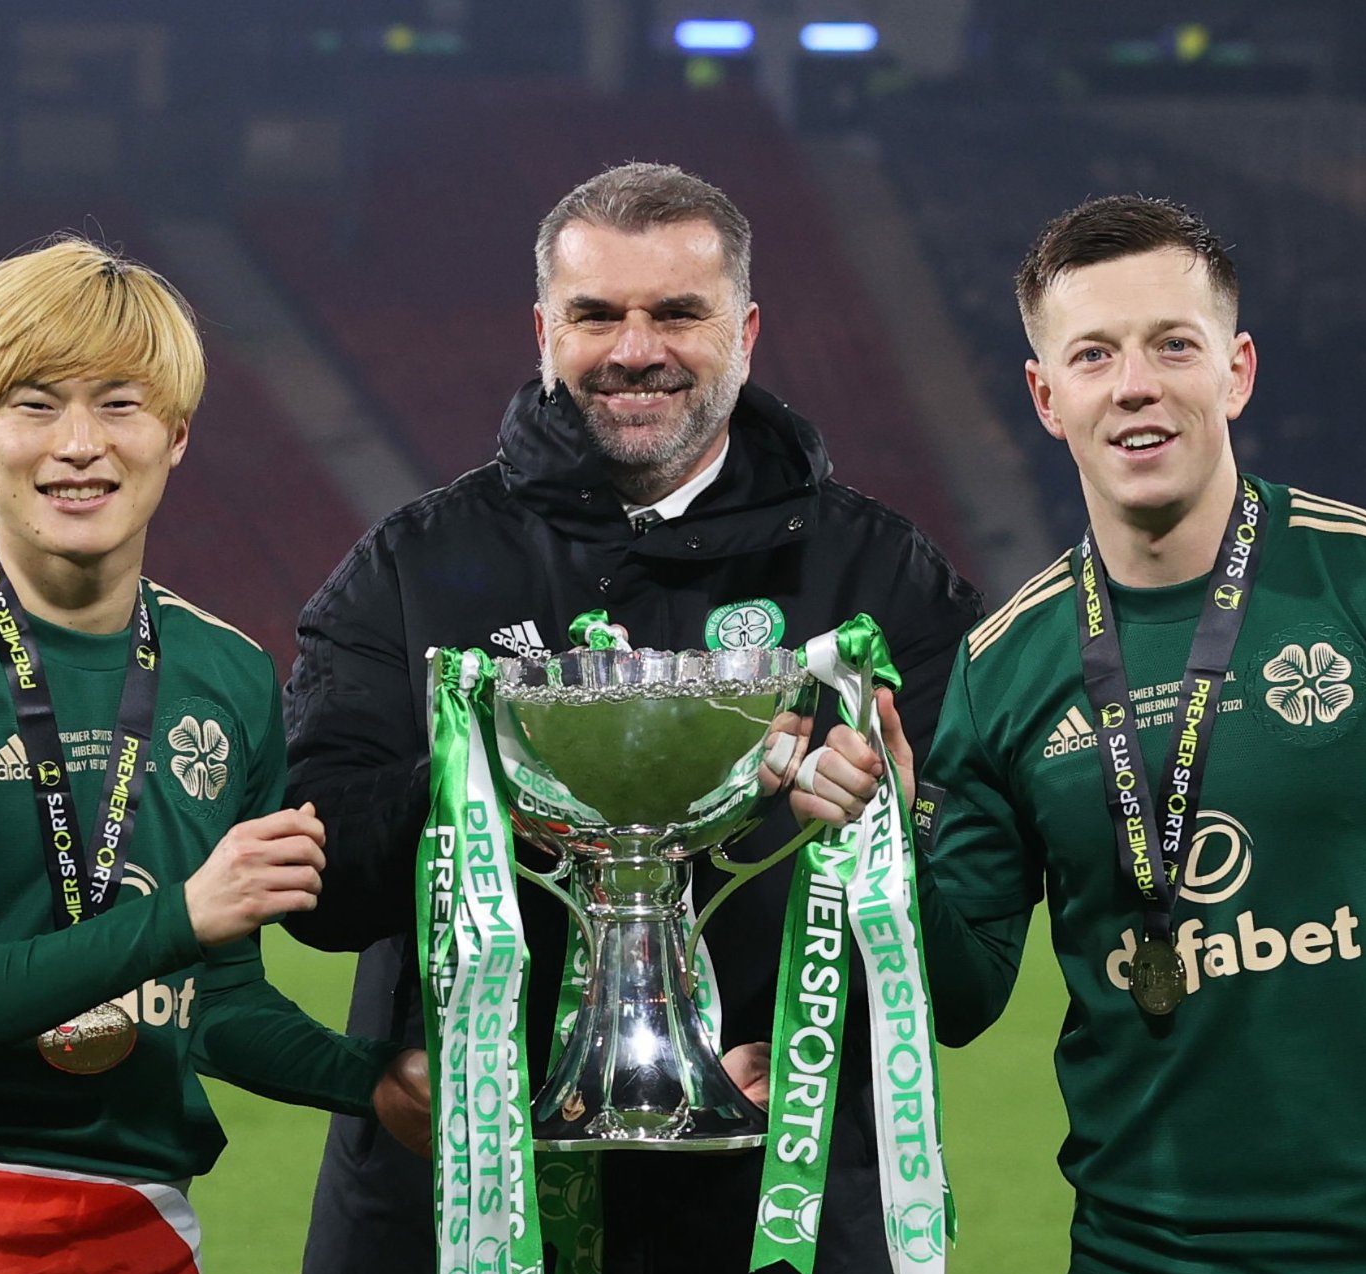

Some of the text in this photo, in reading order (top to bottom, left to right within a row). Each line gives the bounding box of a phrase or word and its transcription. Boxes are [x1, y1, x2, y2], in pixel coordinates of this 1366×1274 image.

[707, 621, 717, 637] THE
[768, 606, 783, 625] CLUB
[490, 631, 552, 660] adidas
[1221, 699, 1244, 712] 2021
[1105, 905, 1362, 995] dfabet
